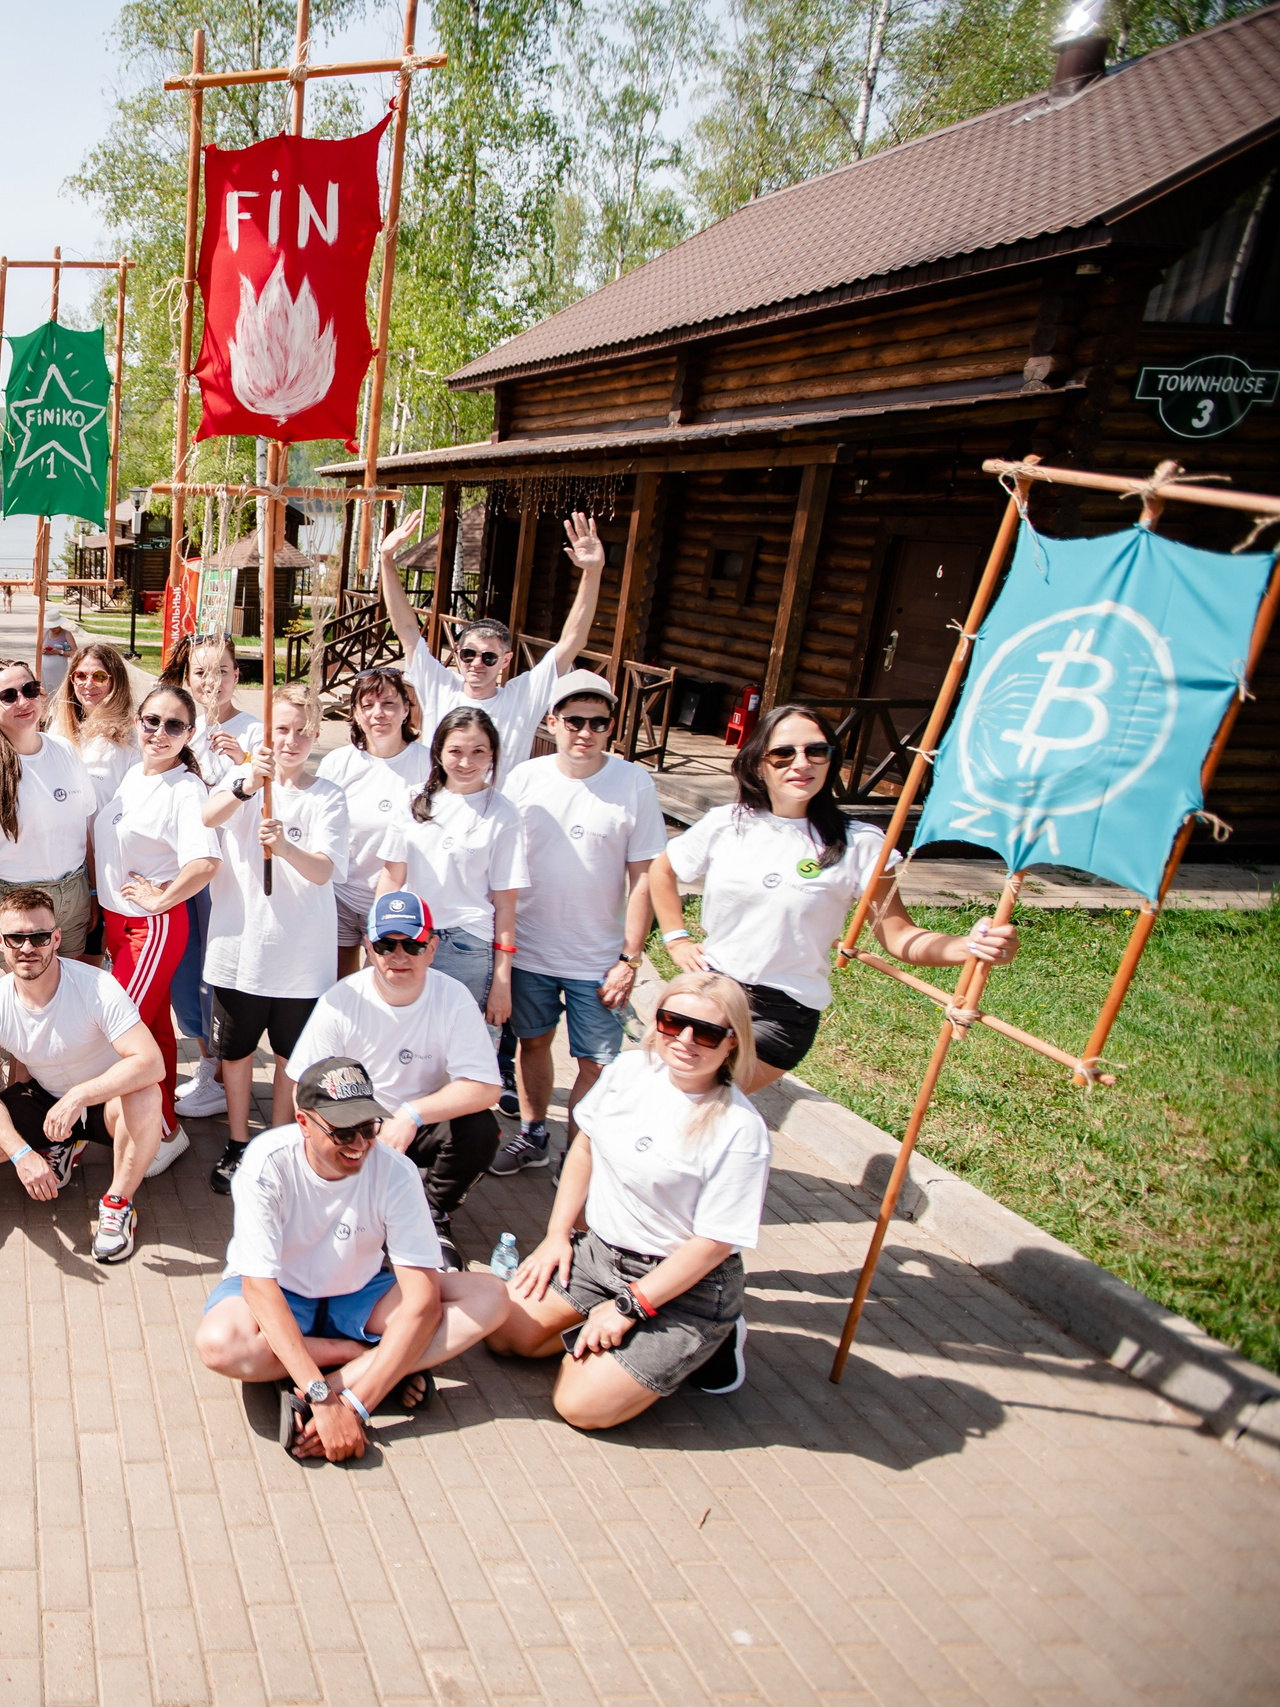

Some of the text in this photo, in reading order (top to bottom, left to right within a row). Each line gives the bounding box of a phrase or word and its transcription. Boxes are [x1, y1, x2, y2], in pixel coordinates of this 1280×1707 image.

[1157, 374, 1266, 394] TOWNHOUSE
[1191, 398, 1214, 429] 3
[46, 451, 58, 479] 1
[936, 564, 943, 579] 6
[800, 862, 819, 874] 5
